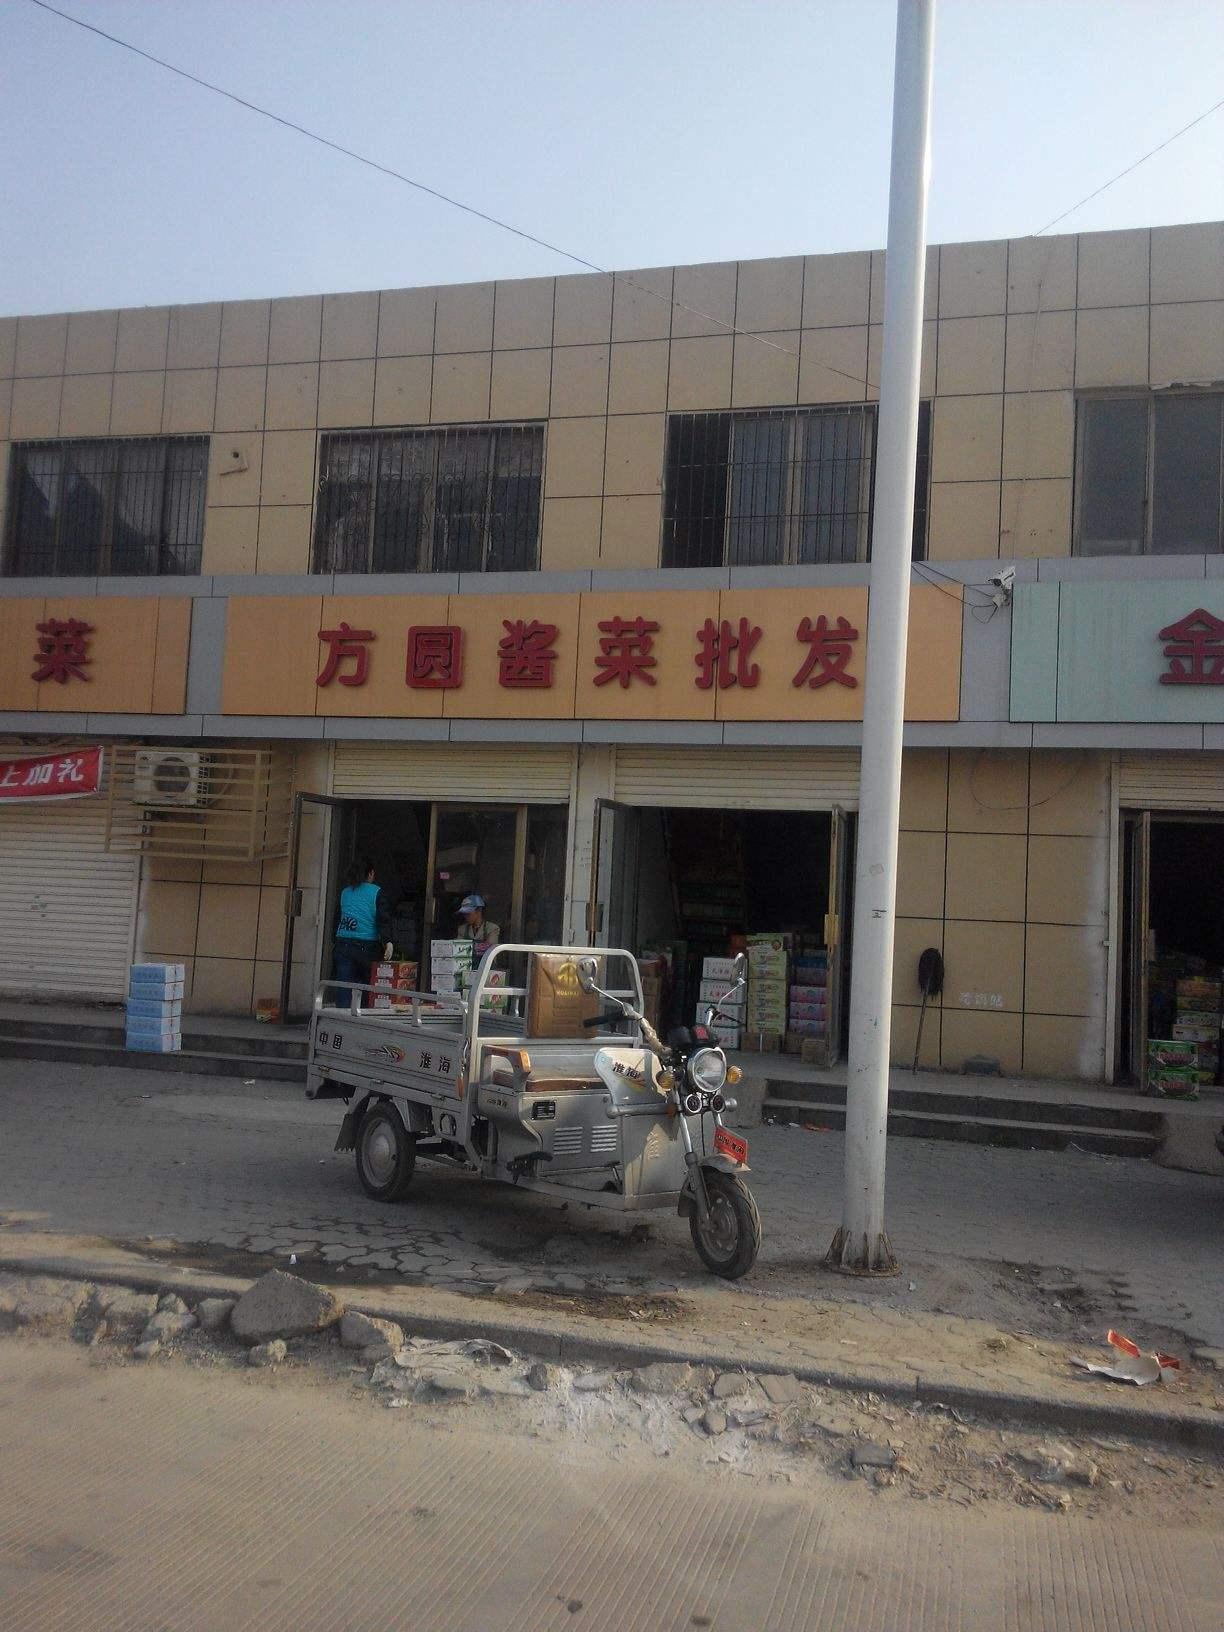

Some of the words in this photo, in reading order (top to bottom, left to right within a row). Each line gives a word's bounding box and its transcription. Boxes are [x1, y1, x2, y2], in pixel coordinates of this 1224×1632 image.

[32, 618, 94, 684] 菜
[315, 614, 858, 690] 方圆酱菜批发
[1159, 608, 1224, 685] 金
[419, 1050, 453, 1074] 淮海
